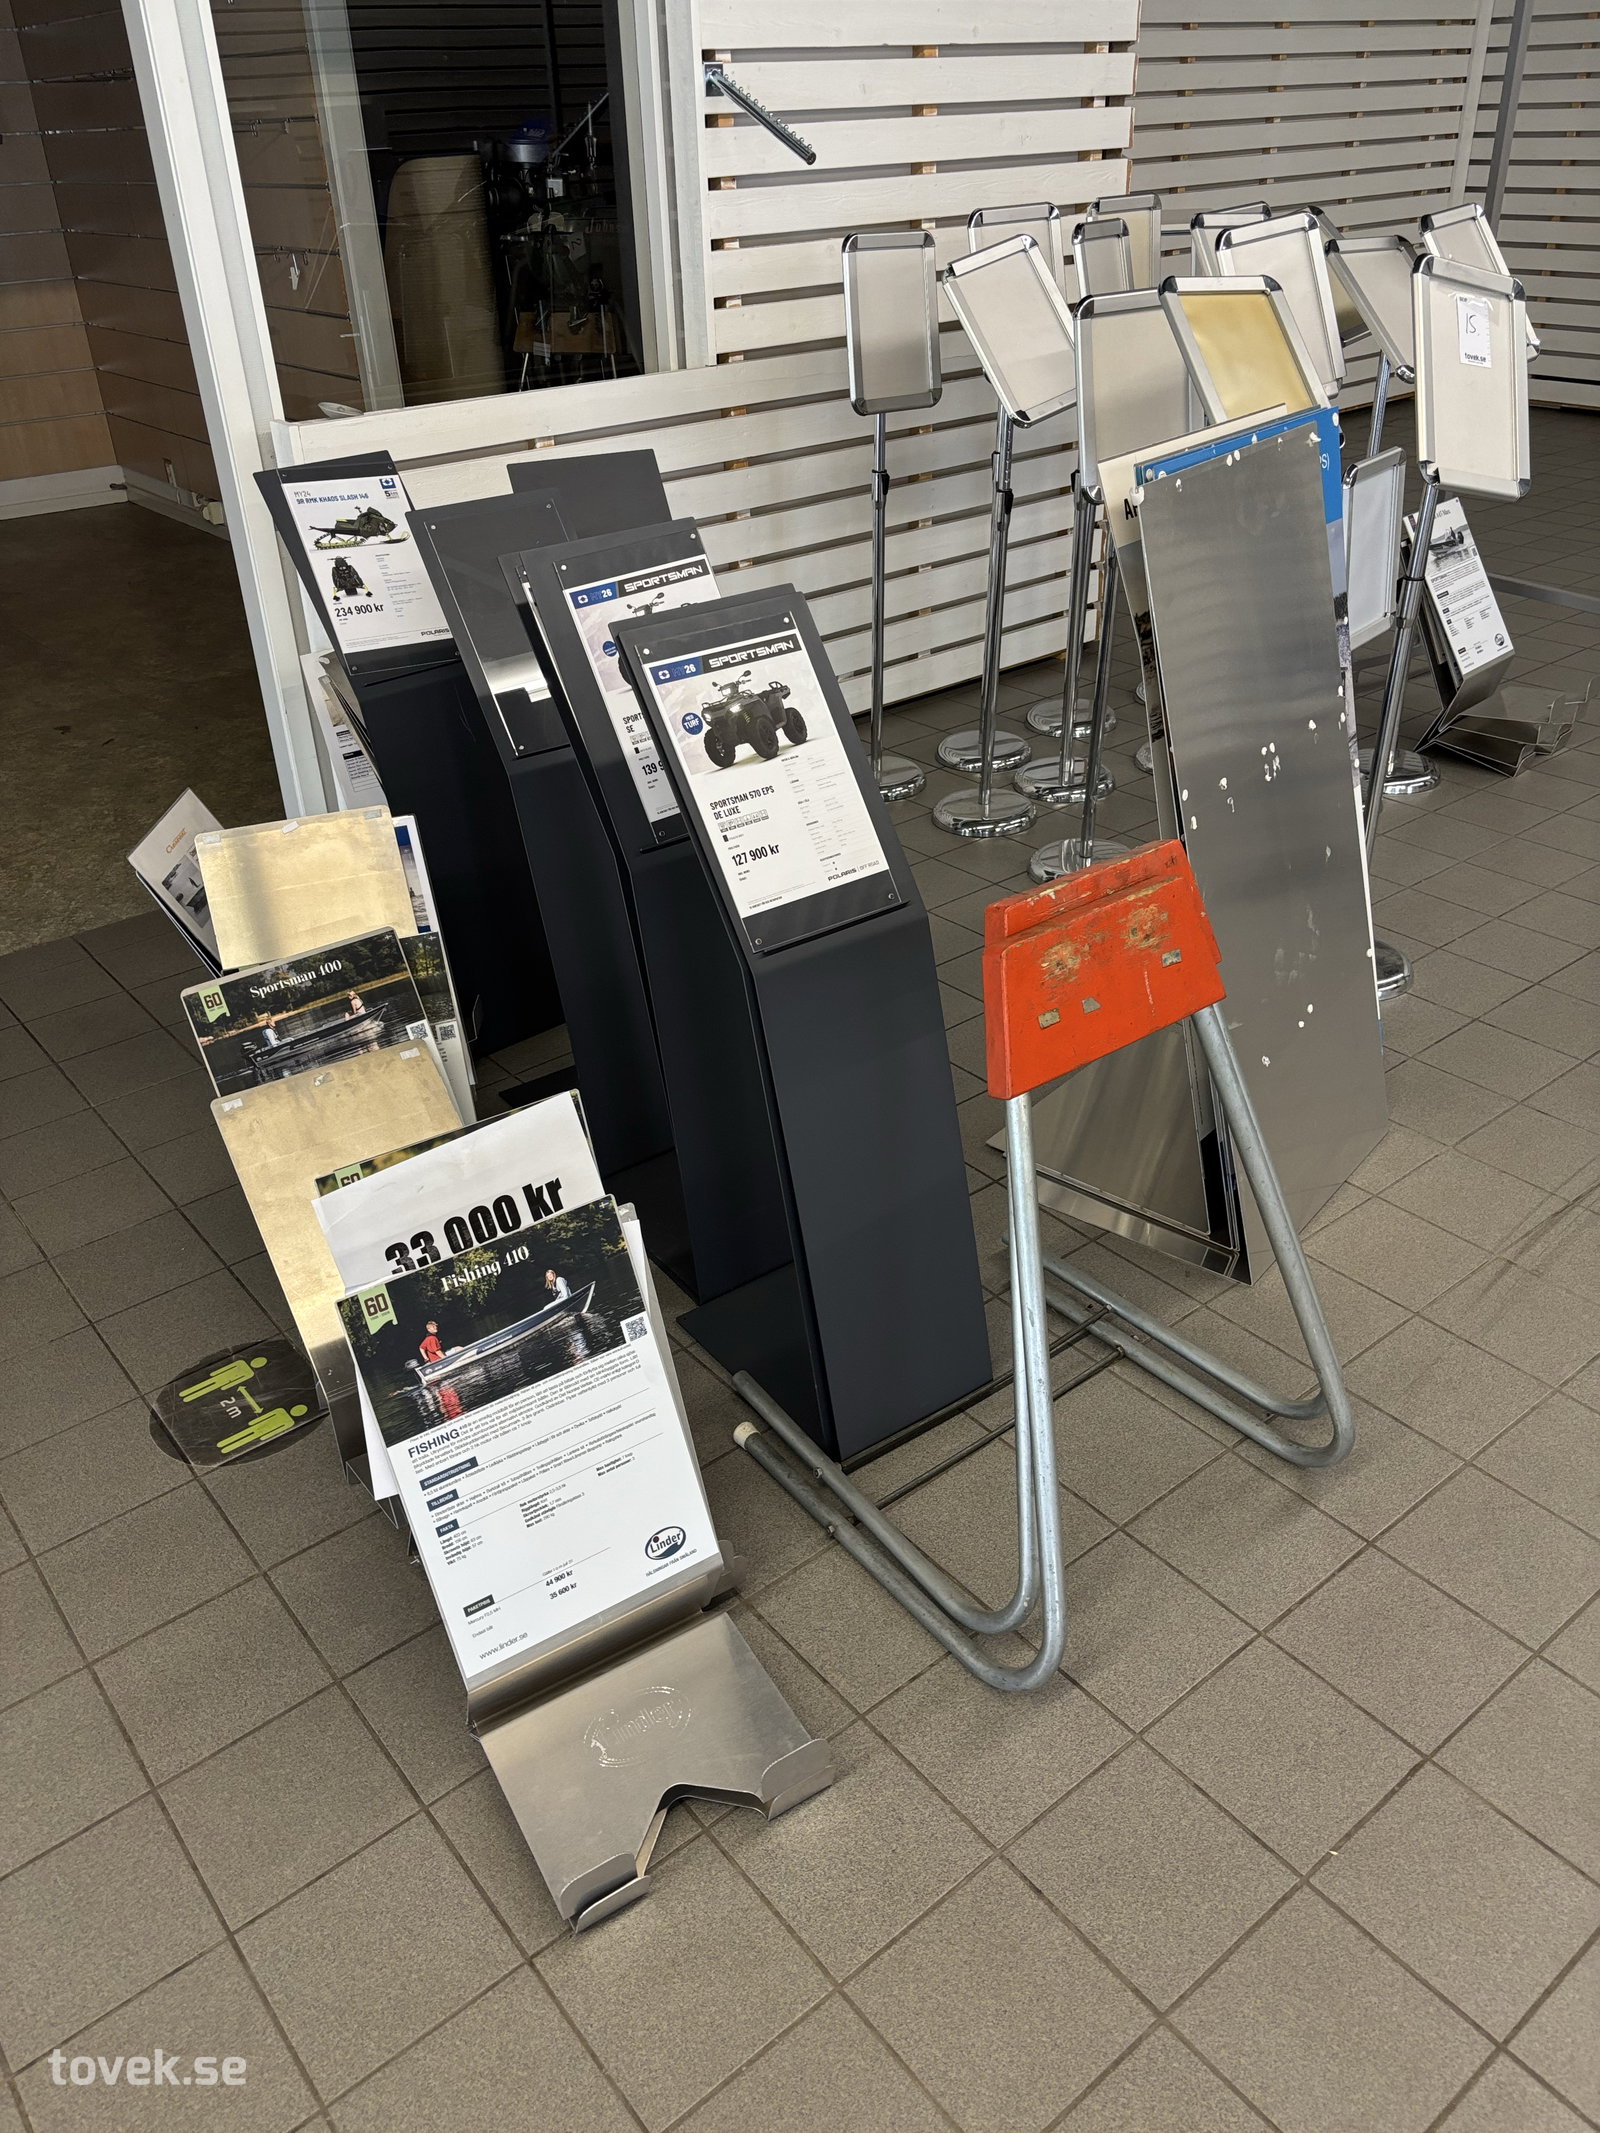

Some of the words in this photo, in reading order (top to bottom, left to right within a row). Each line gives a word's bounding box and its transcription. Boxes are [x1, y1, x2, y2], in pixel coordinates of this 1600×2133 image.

[1465, 352, 1486, 363] tovek.se
[624, 565, 703, 592] SPORTSMAN
[334, 607, 353, 617] 234
[354, 604, 373, 614] 900
[373, 603, 384, 612] kr
[421, 628, 450, 636] POLARIS
[708, 640, 794, 668] SPORTSMAN
[623, 712, 643, 725] SPORT
[683, 718, 700, 730] TURF
[625, 725, 635, 733] SE
[641, 762, 658, 776] 139
[709, 792, 749, 811] SPORTSMAN
[748, 789, 761, 800] 570
[761, 785, 775, 796] EPS
[713, 810, 724, 820] DE
[724, 805, 741, 818] LUXE
[731, 852, 748, 866] 127
[749, 846, 768, 861] 900
[768, 844, 780, 855] kr
[828, 868, 857, 881] POLARIS
[249, 970, 318, 999] Sportsman
[317, 959, 342, 978] 400
[203, 992, 223, 1010] 60
[384, 1230, 442, 1275] 33
[443, 1194, 522, 1255] 000
[522, 1177, 564, 1223] kr
[440, 1260, 502, 1293] Fishing
[502, 1245, 530, 1268] 410
[364, 1293, 389, 1318] 60
[220, 1396, 236, 1408] 2
[226, 1406, 242, 1420] m
[407, 1427, 460, 1457] FISHING
[439, 1523, 454, 1533] FAKTA
[650, 1532, 681, 1553] Linder
[566, 1569, 573, 1577] kr
[570, 1581, 577, 1589] kr
[478, 1630, 528, 1659] www.linder.se
